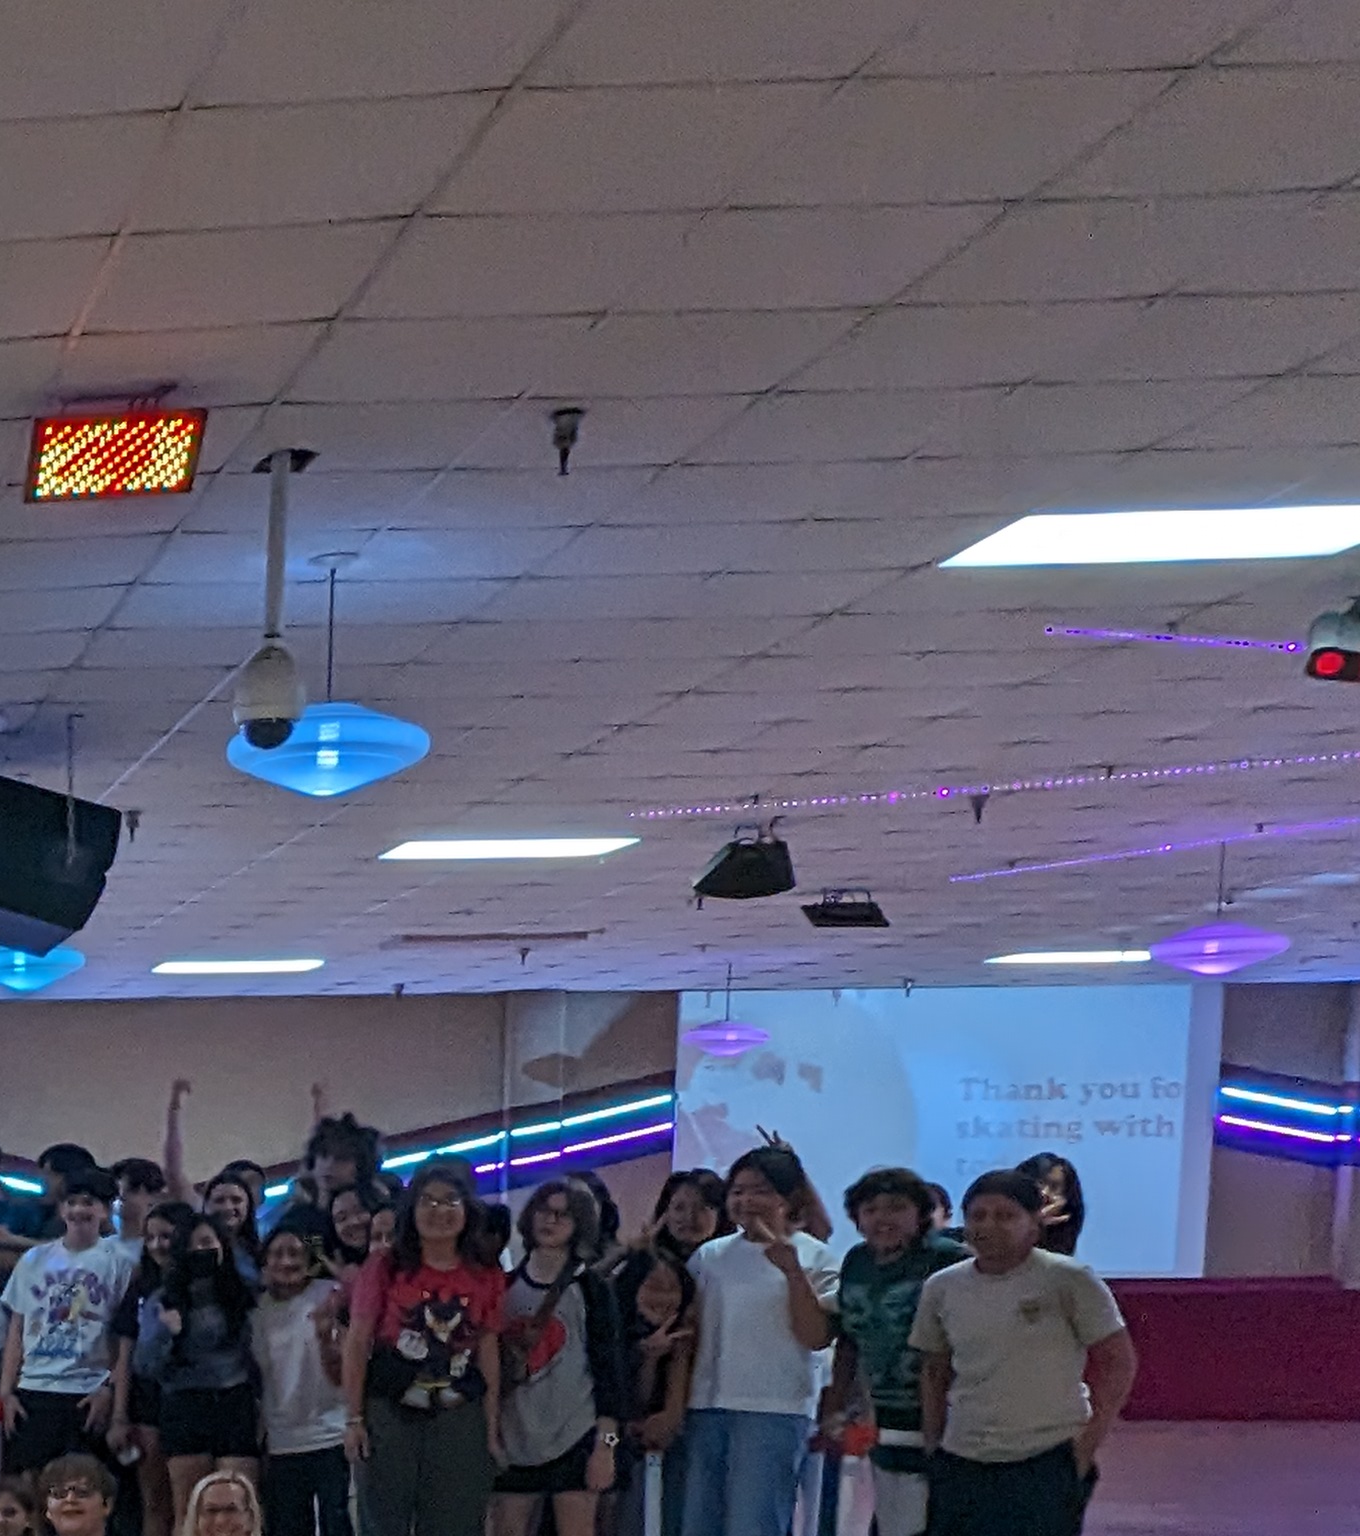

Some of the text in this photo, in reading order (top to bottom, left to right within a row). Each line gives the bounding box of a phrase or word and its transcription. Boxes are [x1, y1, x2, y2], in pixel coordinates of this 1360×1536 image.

[959, 1075, 1068, 1102] Thank
[1078, 1081, 1141, 1106] you
[955, 1113, 1176, 1144] skating with
